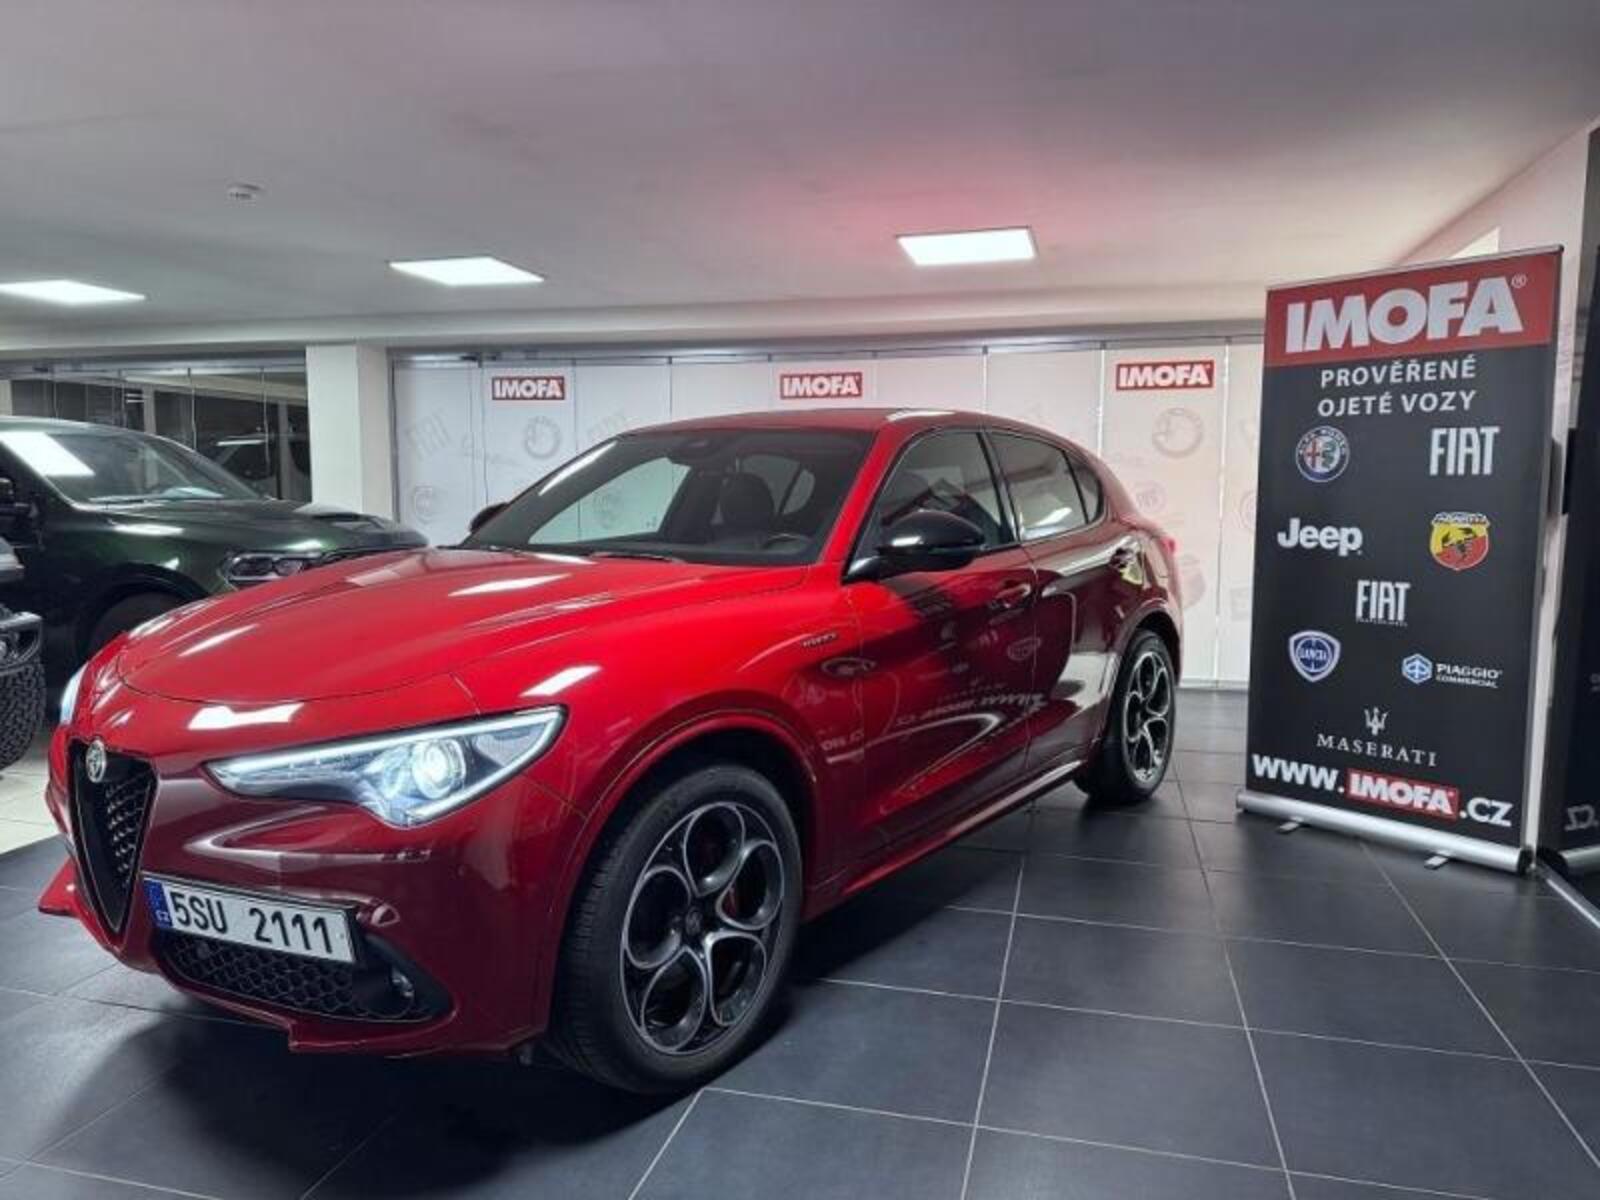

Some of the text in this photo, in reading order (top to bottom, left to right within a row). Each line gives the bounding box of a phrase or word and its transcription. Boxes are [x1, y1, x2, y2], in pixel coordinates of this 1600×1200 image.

[783, 374, 860, 397] IMOFA
[1119, 363, 1211, 388] IMOFA
[1320, 354, 1477, 388] PROVĚŘENÉ
[494, 378, 563, 399] IMOFA
[1317, 390, 1477, 418] OJETÉ VOZY
[1429, 427, 1500, 476] FIAT
[1277, 518, 1362, 557] Jeep
[1355, 580, 1411, 621] FIAT
[1435, 663, 1500, 679] PIAGGIO
[1317, 733, 1440, 767] MASERATI
[170, 891, 333, 954] 5SU 2111
